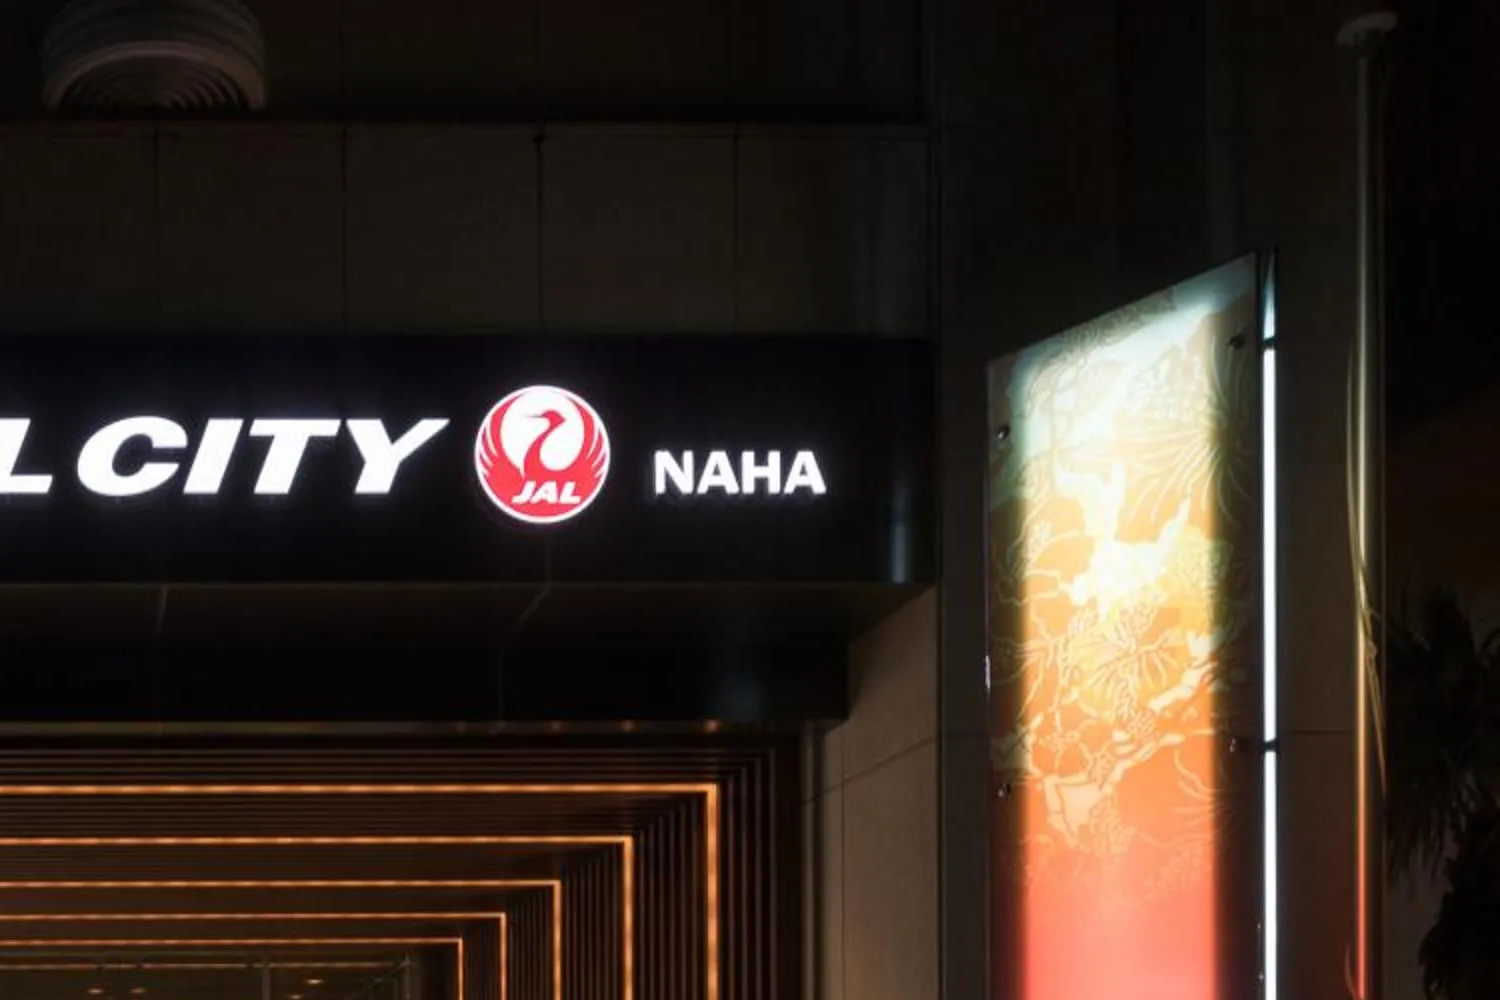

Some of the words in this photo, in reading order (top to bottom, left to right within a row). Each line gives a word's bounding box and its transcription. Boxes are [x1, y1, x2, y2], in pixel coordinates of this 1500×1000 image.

[76, 415, 450, 497] CITY
[653, 449, 827, 496] NAHA
[511, 480, 581, 504] JAL
